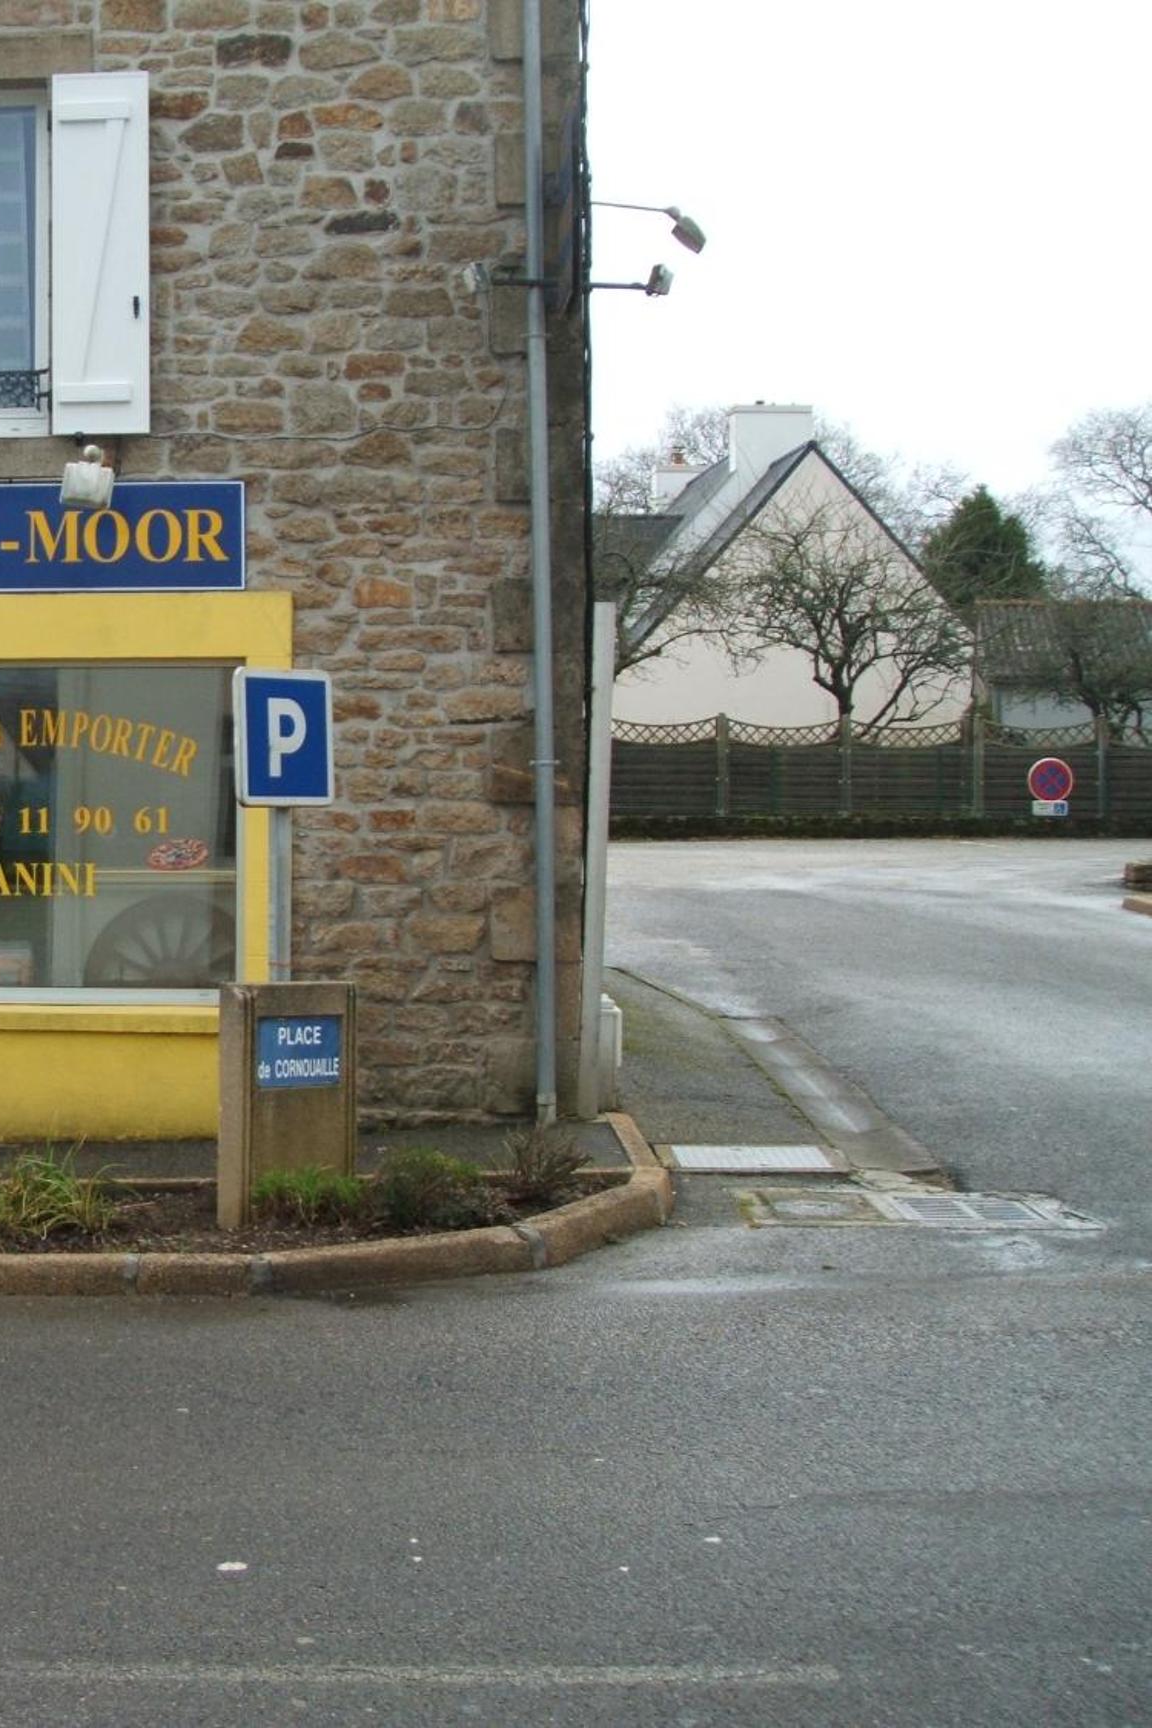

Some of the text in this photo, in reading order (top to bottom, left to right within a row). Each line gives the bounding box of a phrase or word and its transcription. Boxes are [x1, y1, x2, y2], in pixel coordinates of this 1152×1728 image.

[19, 708, 199, 777] EMPORTER
[267, 697, 307, 778] P
[19, 806, 49, 834] 11
[74, 806, 113, 834] 90
[133, 806, 169, 834] 61
[277, 1026, 322, 1046] PLACE
[257, 1057, 340, 1079] de CORNOUAILLE
